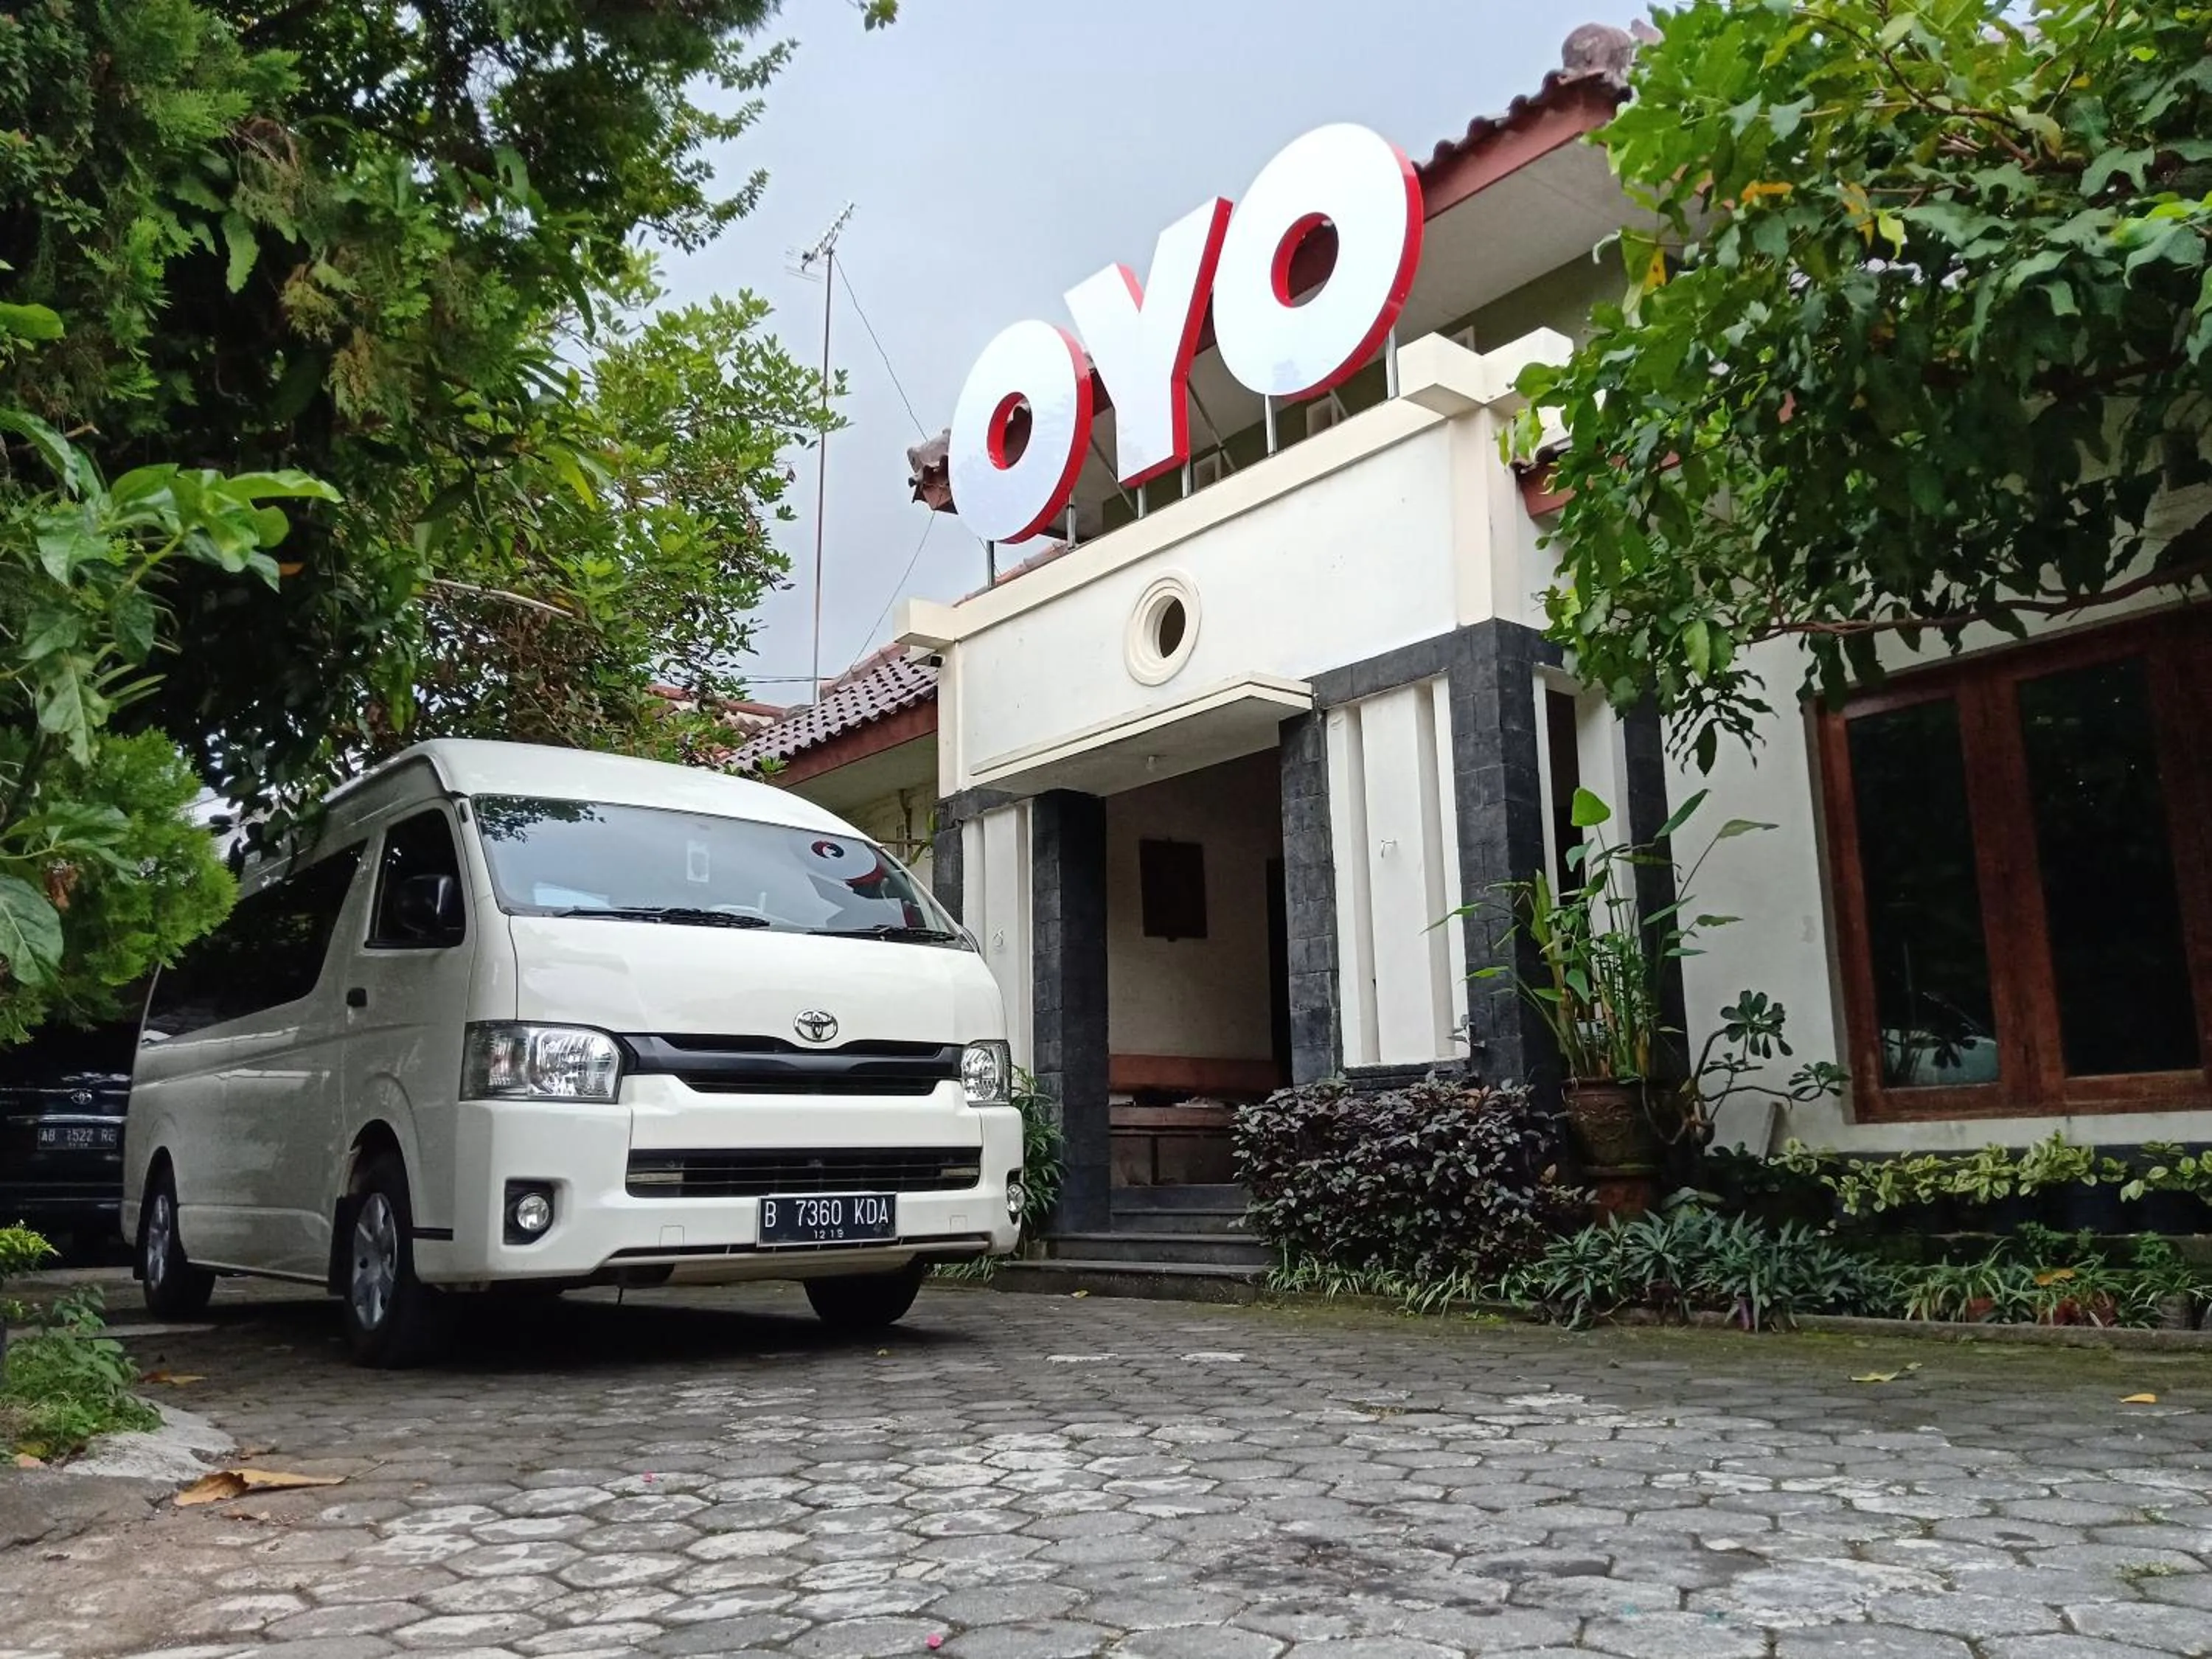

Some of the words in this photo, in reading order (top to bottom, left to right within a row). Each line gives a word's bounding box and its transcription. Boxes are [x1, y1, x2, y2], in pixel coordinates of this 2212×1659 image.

[948, 122, 1423, 544] OYO
[765, 1201, 776, 1228] B
[796, 1200, 842, 1226] 7360
[855, 1197, 888, 1225] KDA
